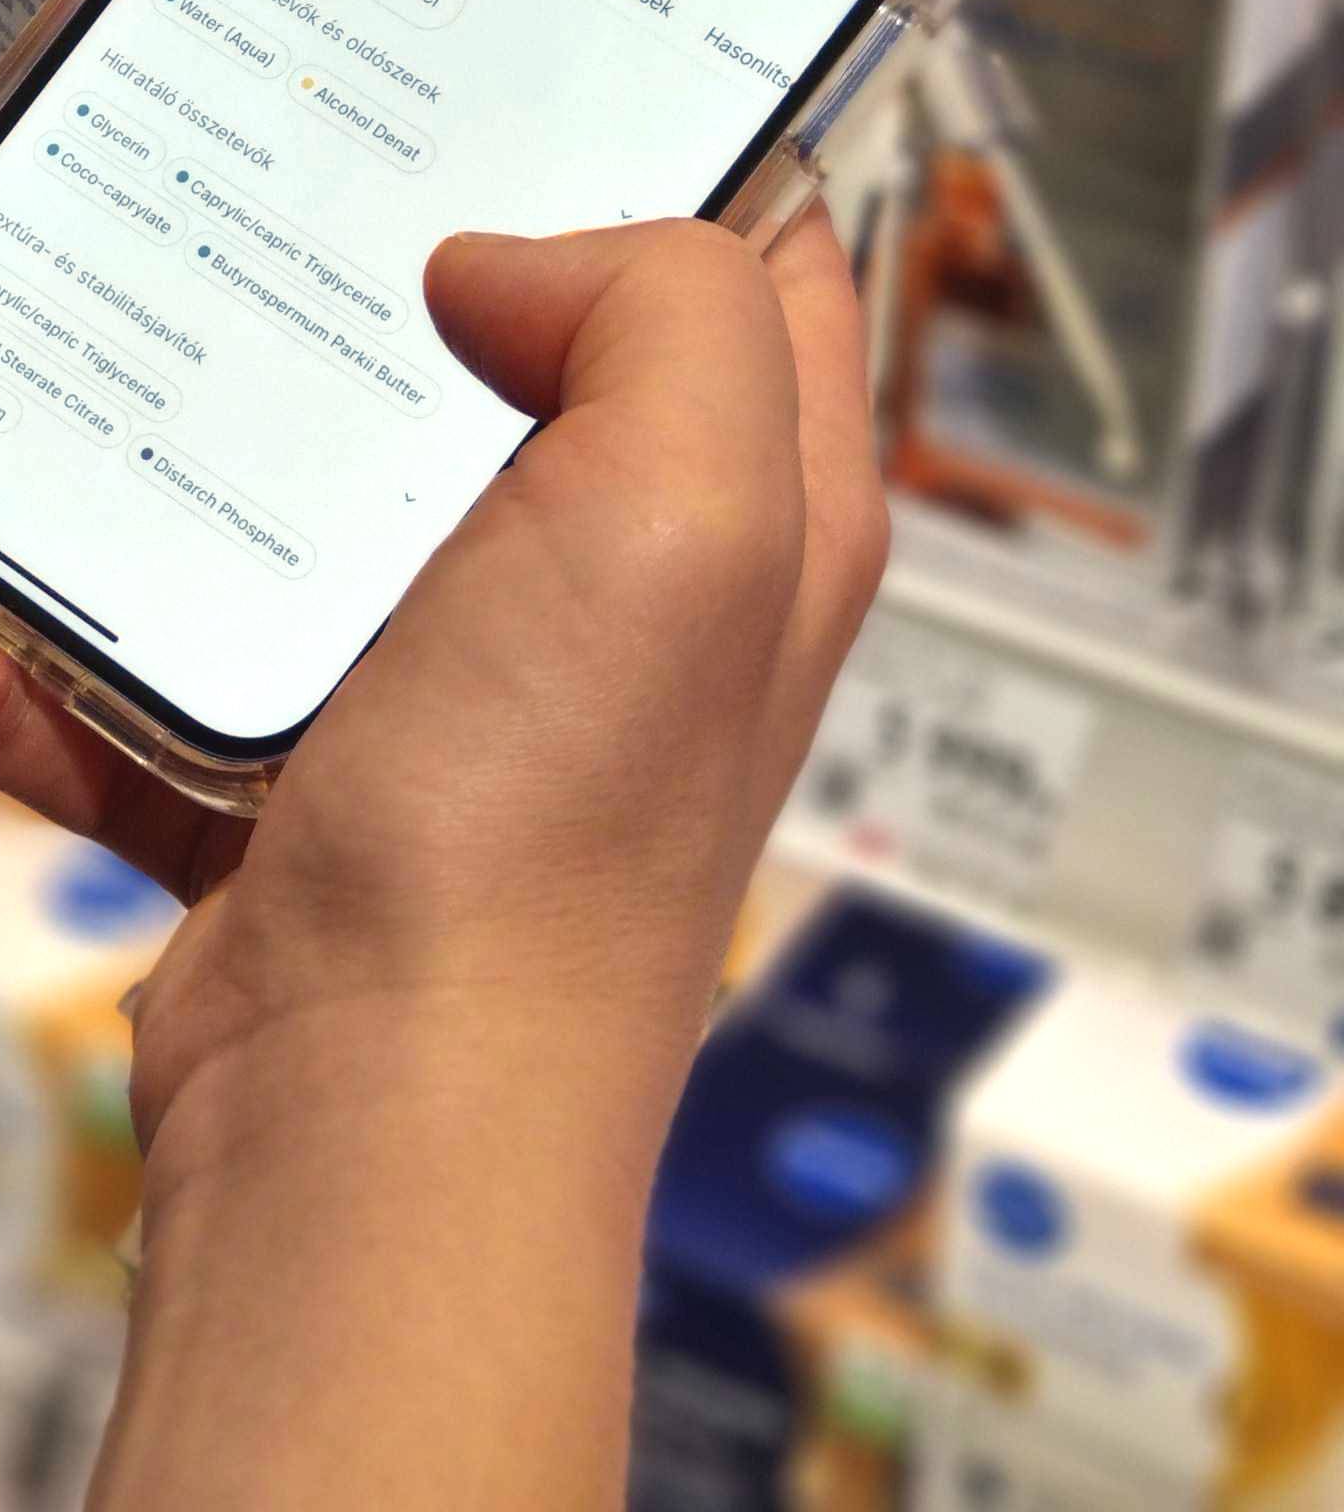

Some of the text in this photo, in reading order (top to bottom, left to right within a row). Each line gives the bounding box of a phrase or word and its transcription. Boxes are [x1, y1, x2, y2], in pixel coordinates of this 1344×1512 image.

[223, 26, 276, 68] (Aqua)
[321, 22, 345, 41] és
[345, 37, 441, 105] oldószerek
[703, 26, 791, 89] Hasonlíts
[90, 113, 150, 161] Glycerin
[100, 47, 275, 171] Hidratáló összetevők
[313, 87, 421, 162] Alcohol Denat
[60, 152, 172, 234] Coco-caprylate
[190, 180, 392, 322] Caprylic/capric Triglyceride
[54, 252, 76, 275] és
[77, 271, 207, 366] stabilitásjavítók
[210, 253, 426, 404] Butyrospermum Parkii Butter
[0, 349, 62, 400] Stearate
[63, 393, 114, 436] Citrate
[81, 342, 166, 410] Triglyceride
[153, 456, 300, 567] Distarch Phosphate
